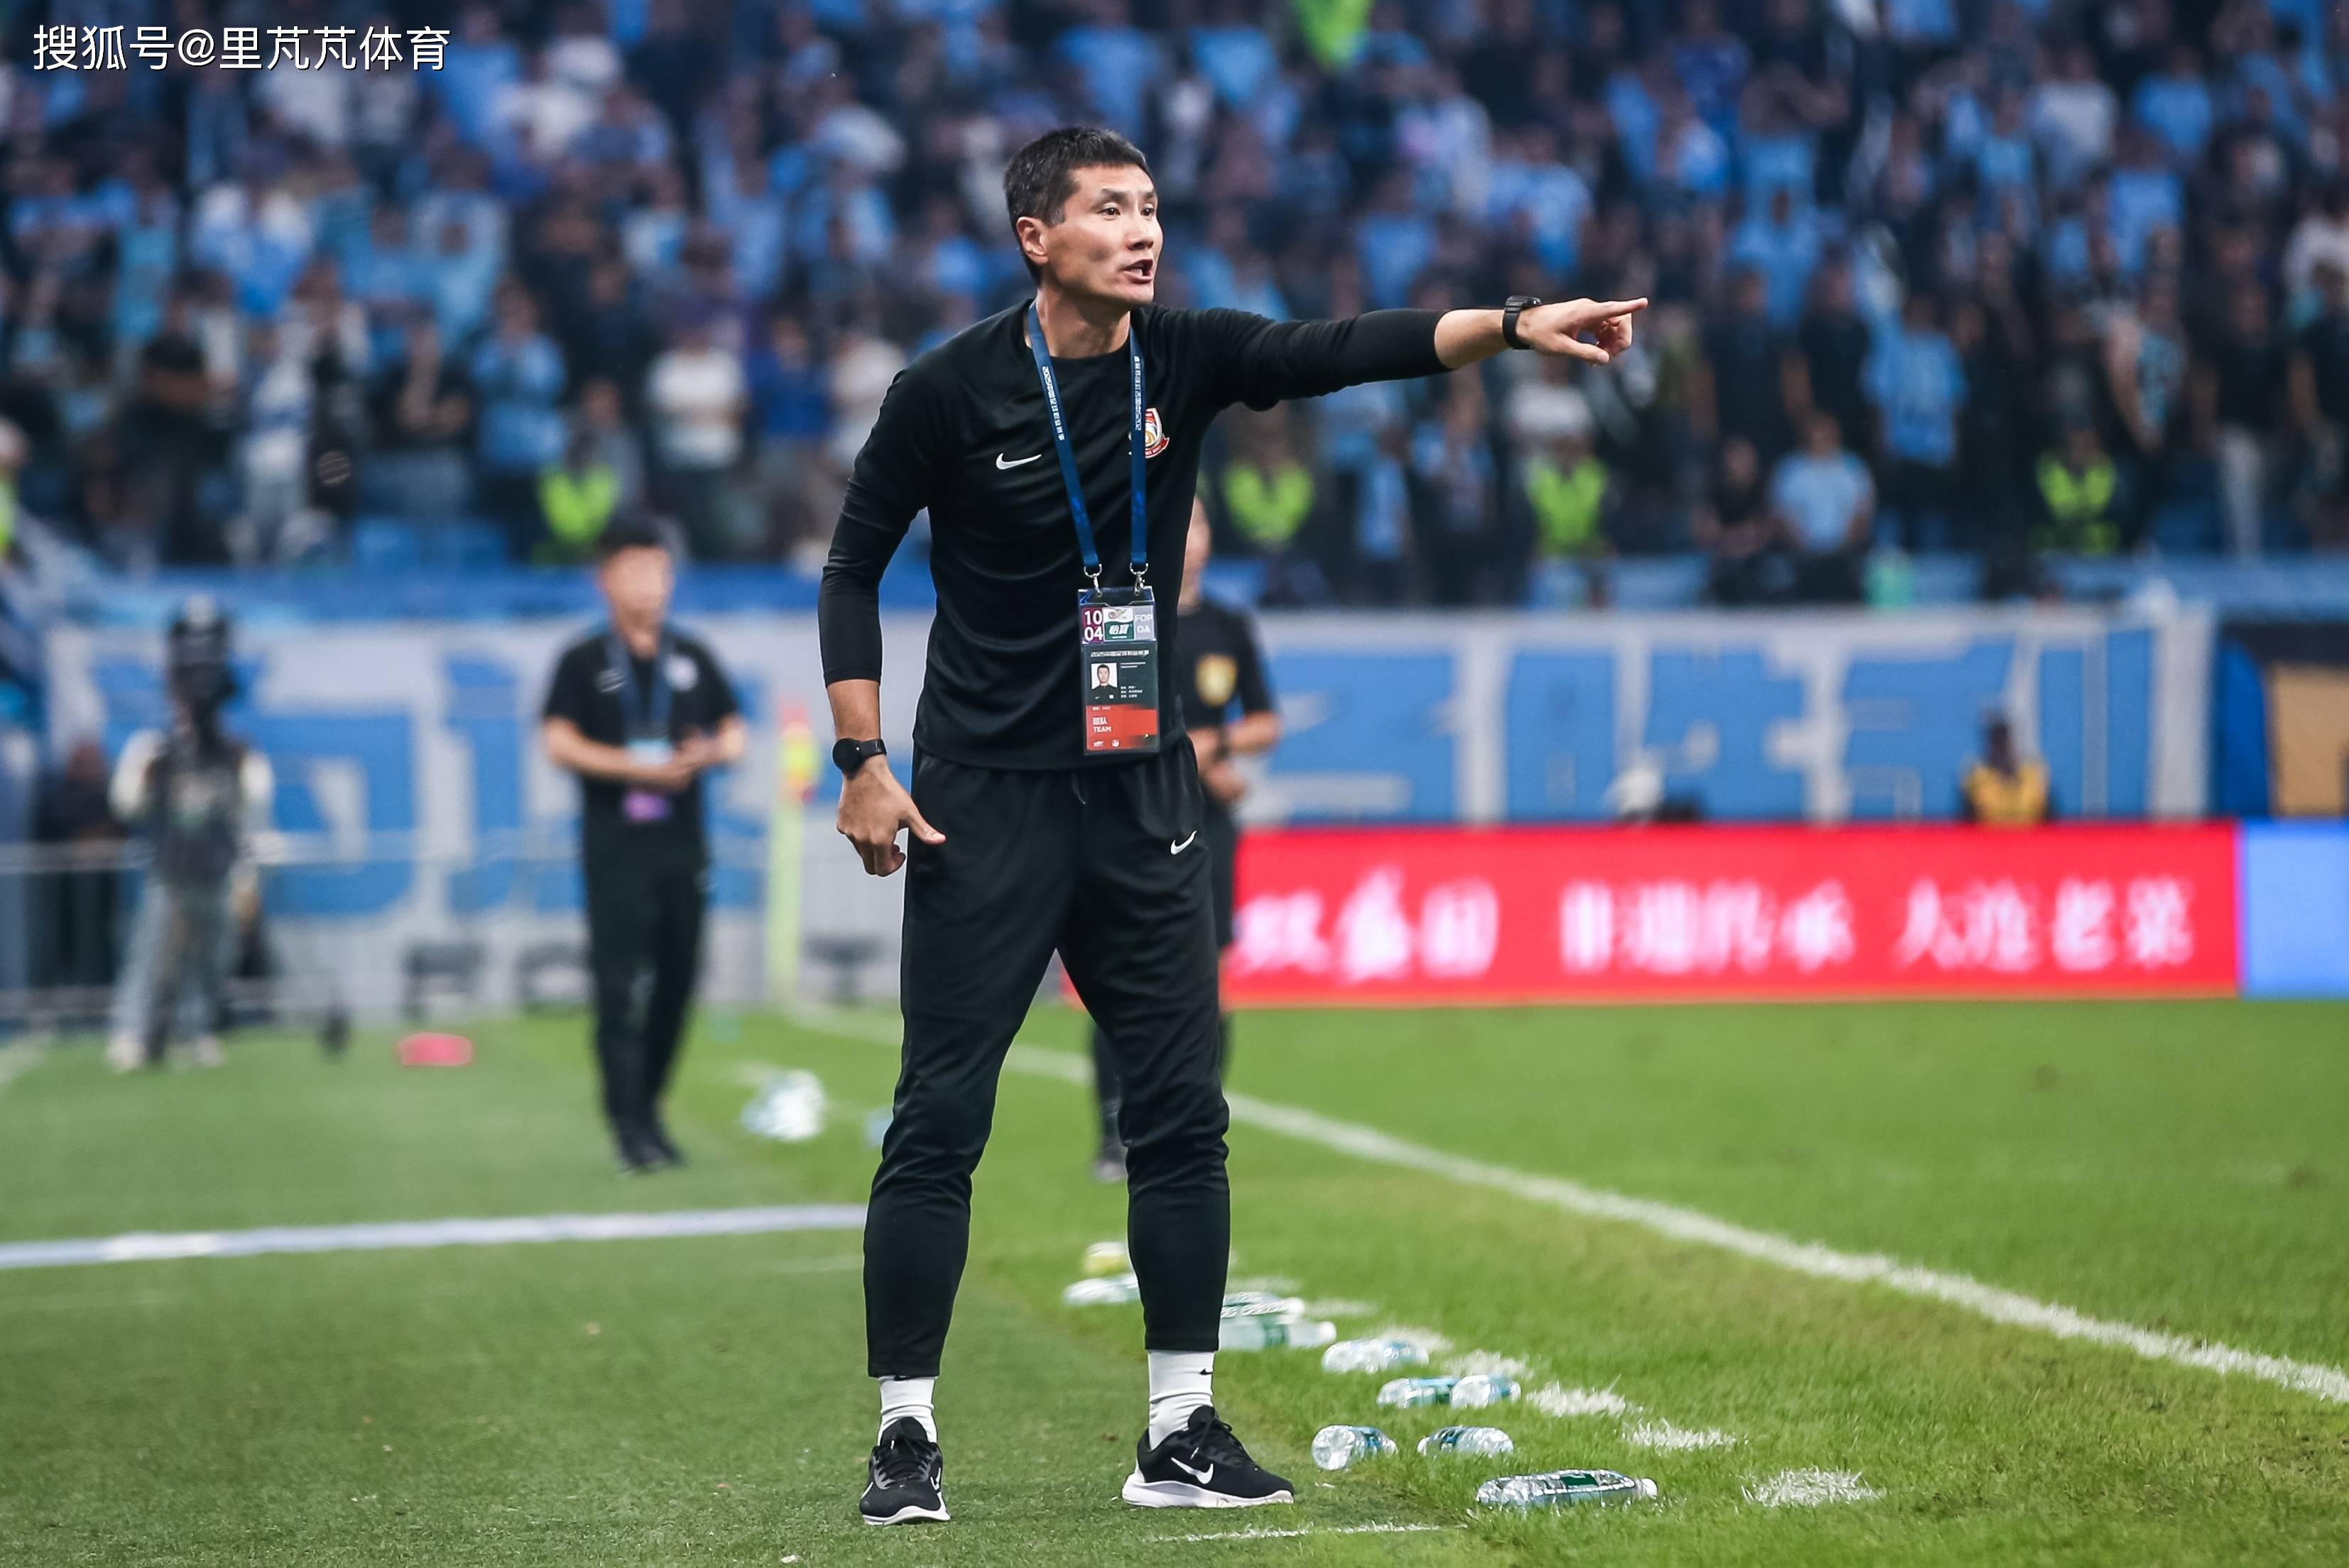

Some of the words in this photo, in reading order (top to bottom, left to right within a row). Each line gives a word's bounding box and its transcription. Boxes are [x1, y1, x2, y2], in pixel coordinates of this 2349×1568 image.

[1084, 610, 1103, 625] 10
[1135, 614, 1153, 622] FOP
[1084, 626, 1103, 641] 04
